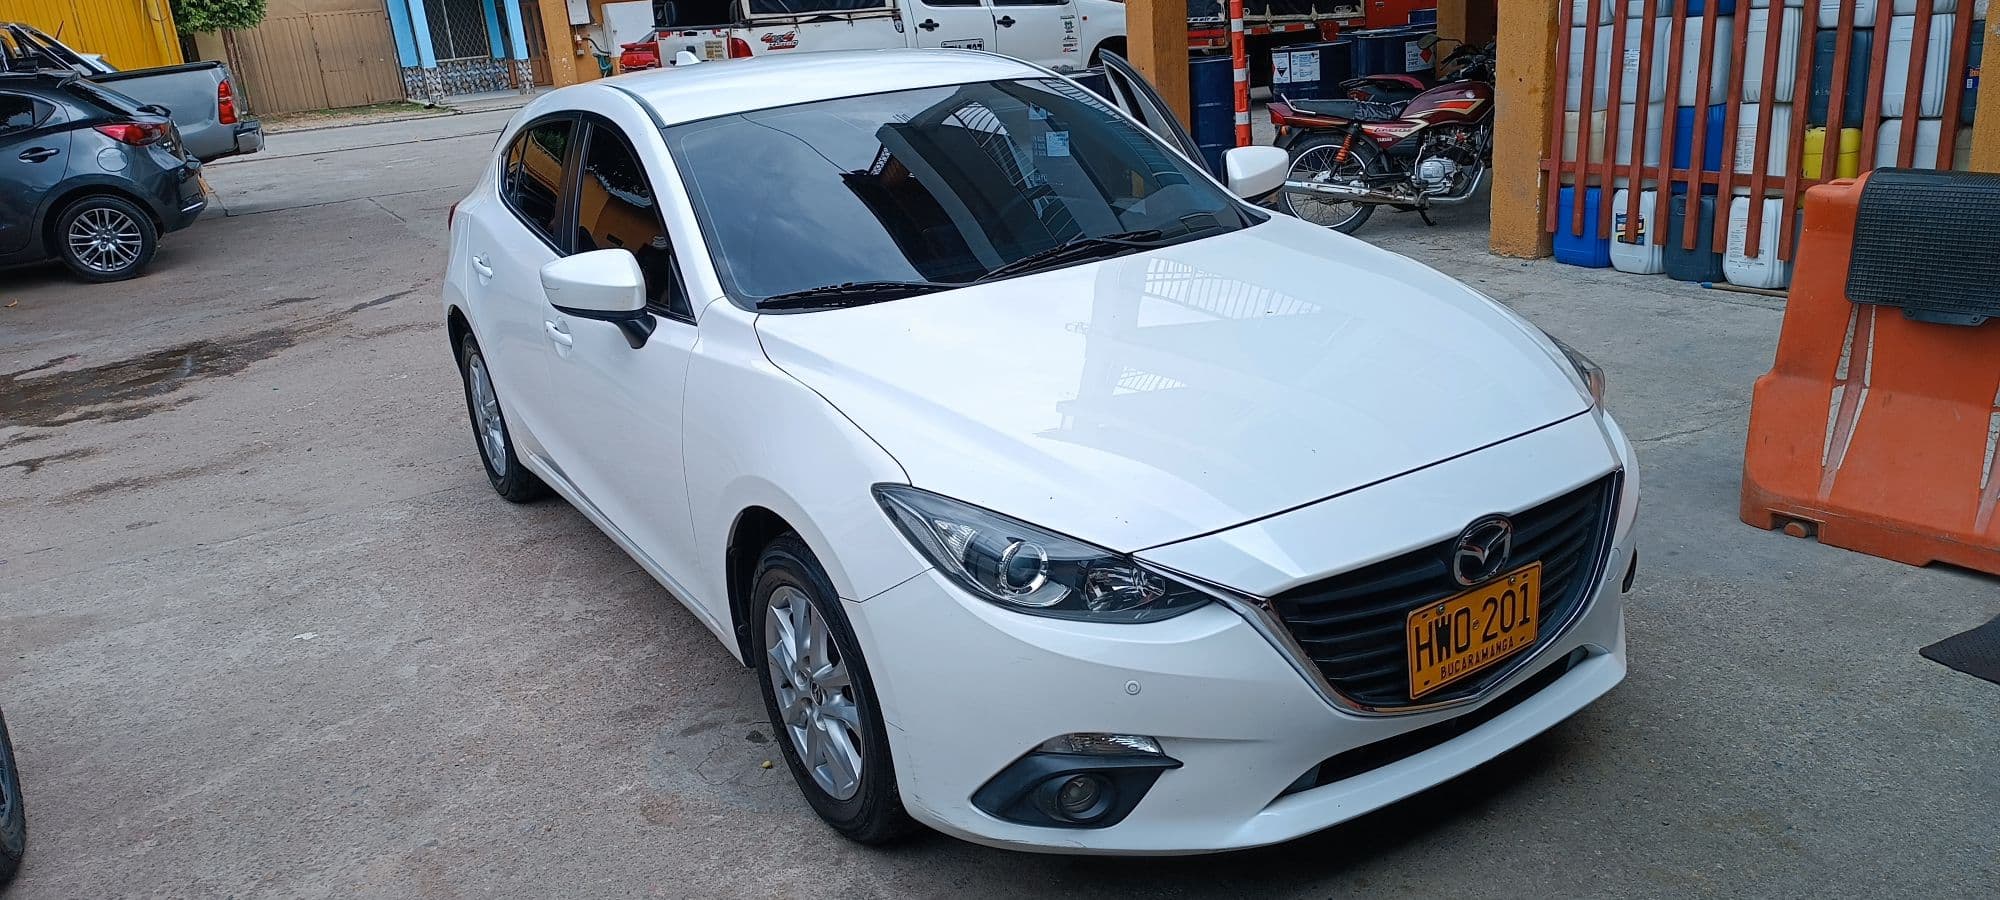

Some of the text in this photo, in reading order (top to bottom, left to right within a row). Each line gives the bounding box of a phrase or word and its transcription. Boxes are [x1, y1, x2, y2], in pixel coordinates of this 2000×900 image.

[1414, 582, 1531, 672] HWO 201
[1440, 636, 1514, 680] BUCARAMANGA
